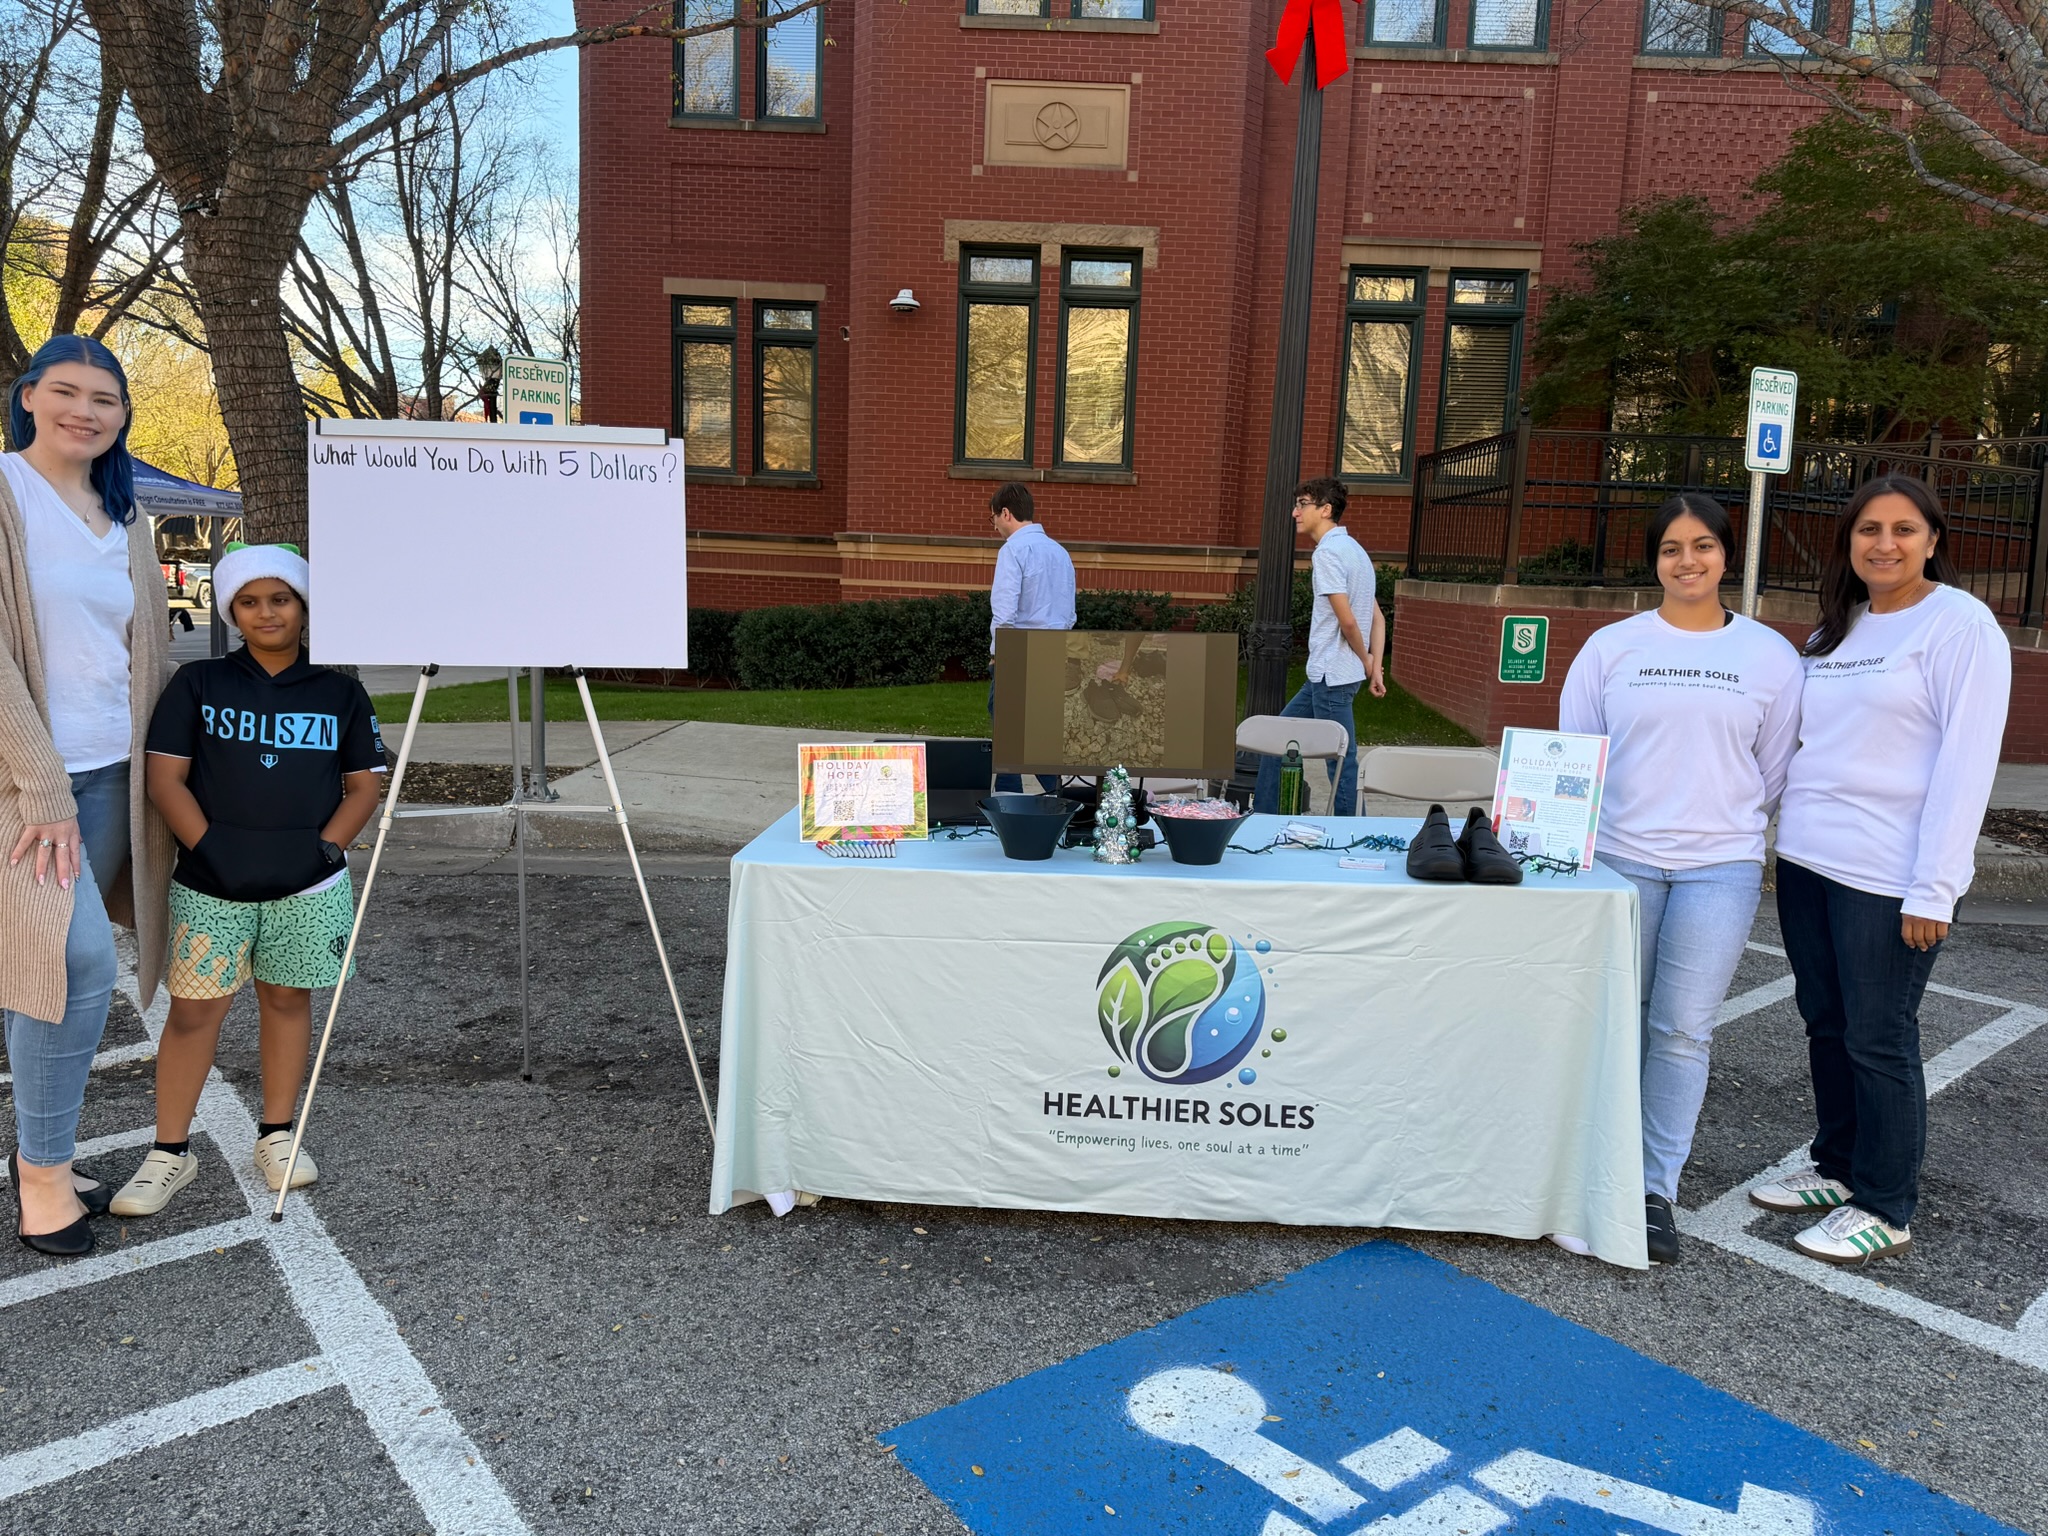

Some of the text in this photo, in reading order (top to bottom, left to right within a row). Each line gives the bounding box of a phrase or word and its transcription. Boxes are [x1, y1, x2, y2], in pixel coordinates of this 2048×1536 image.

[508, 366, 564, 384] RESERVED
[1754, 378, 1793, 395] RESERVED
[512, 388, 561, 405] PARKING
[1755, 400, 1790, 416] PARKING
[313, 443, 358, 466] What
[364, 444, 417, 468] Would
[424, 446, 458, 471] You
[468, 447, 495, 474] Do
[501, 449, 547, 476] With
[559, 450, 579, 477] 5
[1857, 657, 1885, 667] SOLES
[1639, 668, 1740, 684] HEALTHIER SOLES
[816, 761, 870, 770] HOLIDAY
[1513, 757, 1592, 771] HOLIDAY HOPE
[827, 771, 860, 780] HOPE
[1043, 1091, 1315, 1130] HEALTHIER SOLES
[1177, 1139, 1200, 1151] one
[1205, 1141, 1232, 1154] soul
[1237, 1142, 1252, 1155] at
[1258, 1145, 1265, 1155] a
